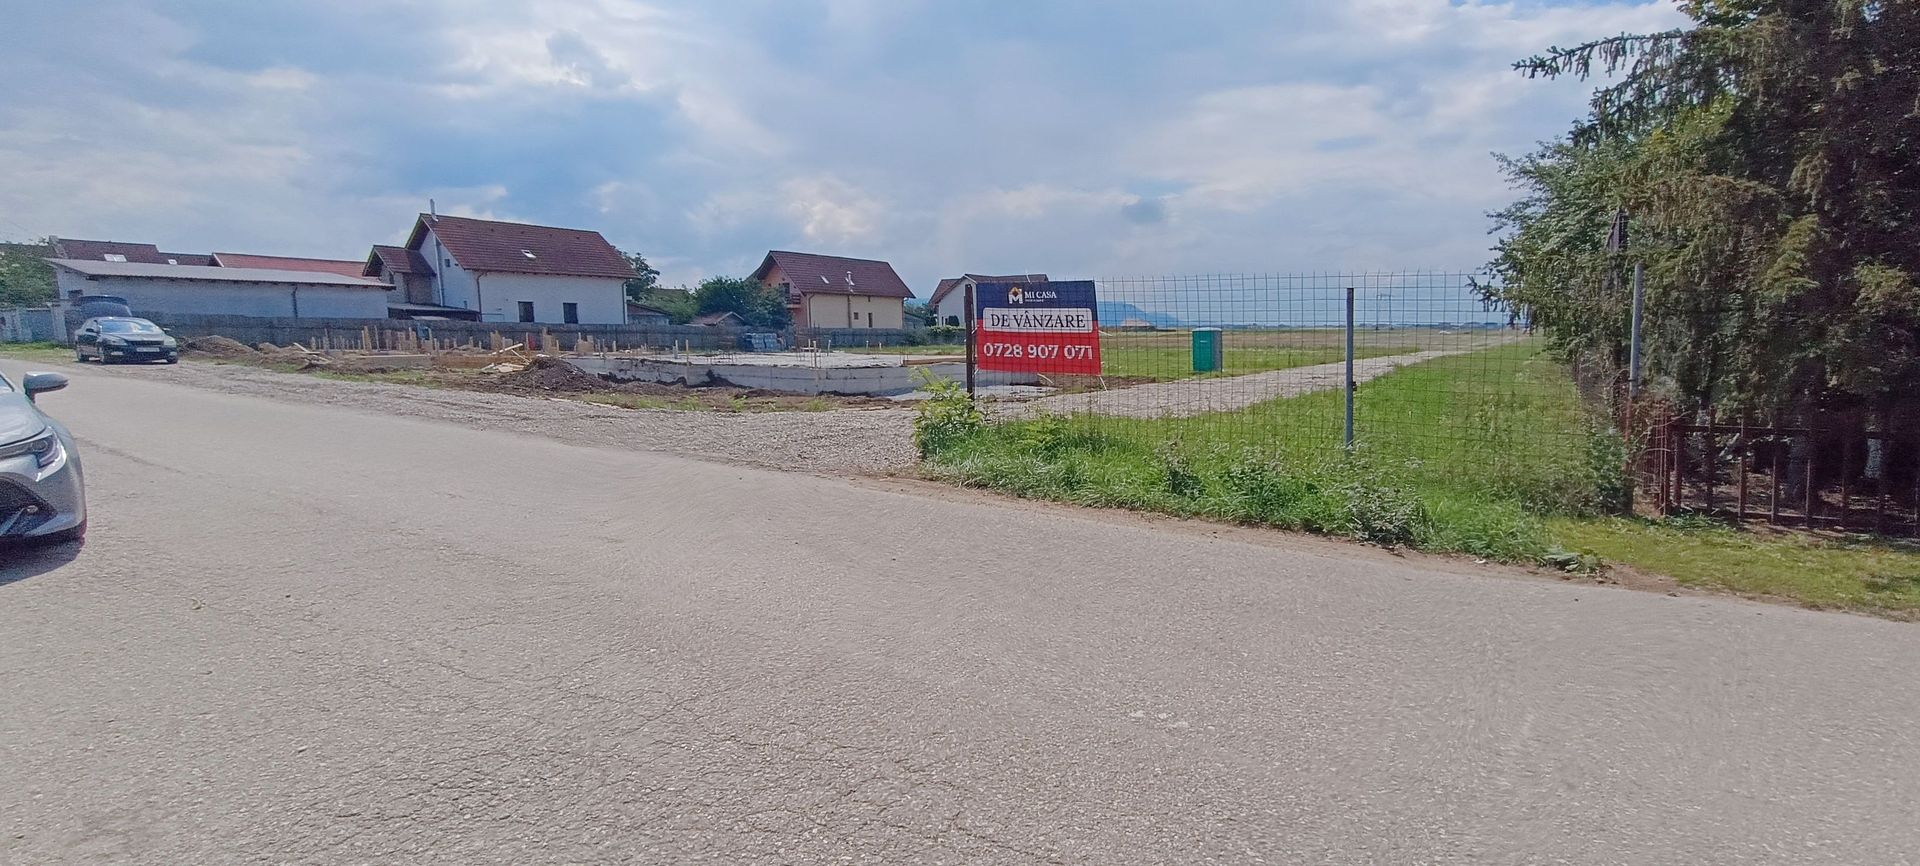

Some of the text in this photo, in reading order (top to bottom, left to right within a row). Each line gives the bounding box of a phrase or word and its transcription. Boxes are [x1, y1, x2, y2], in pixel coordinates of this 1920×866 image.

[1024, 291, 1057, 299] MI CASA
[991, 310, 1086, 328] DE VÂNZARE
[983, 342, 1093, 360] 0728 907 071
